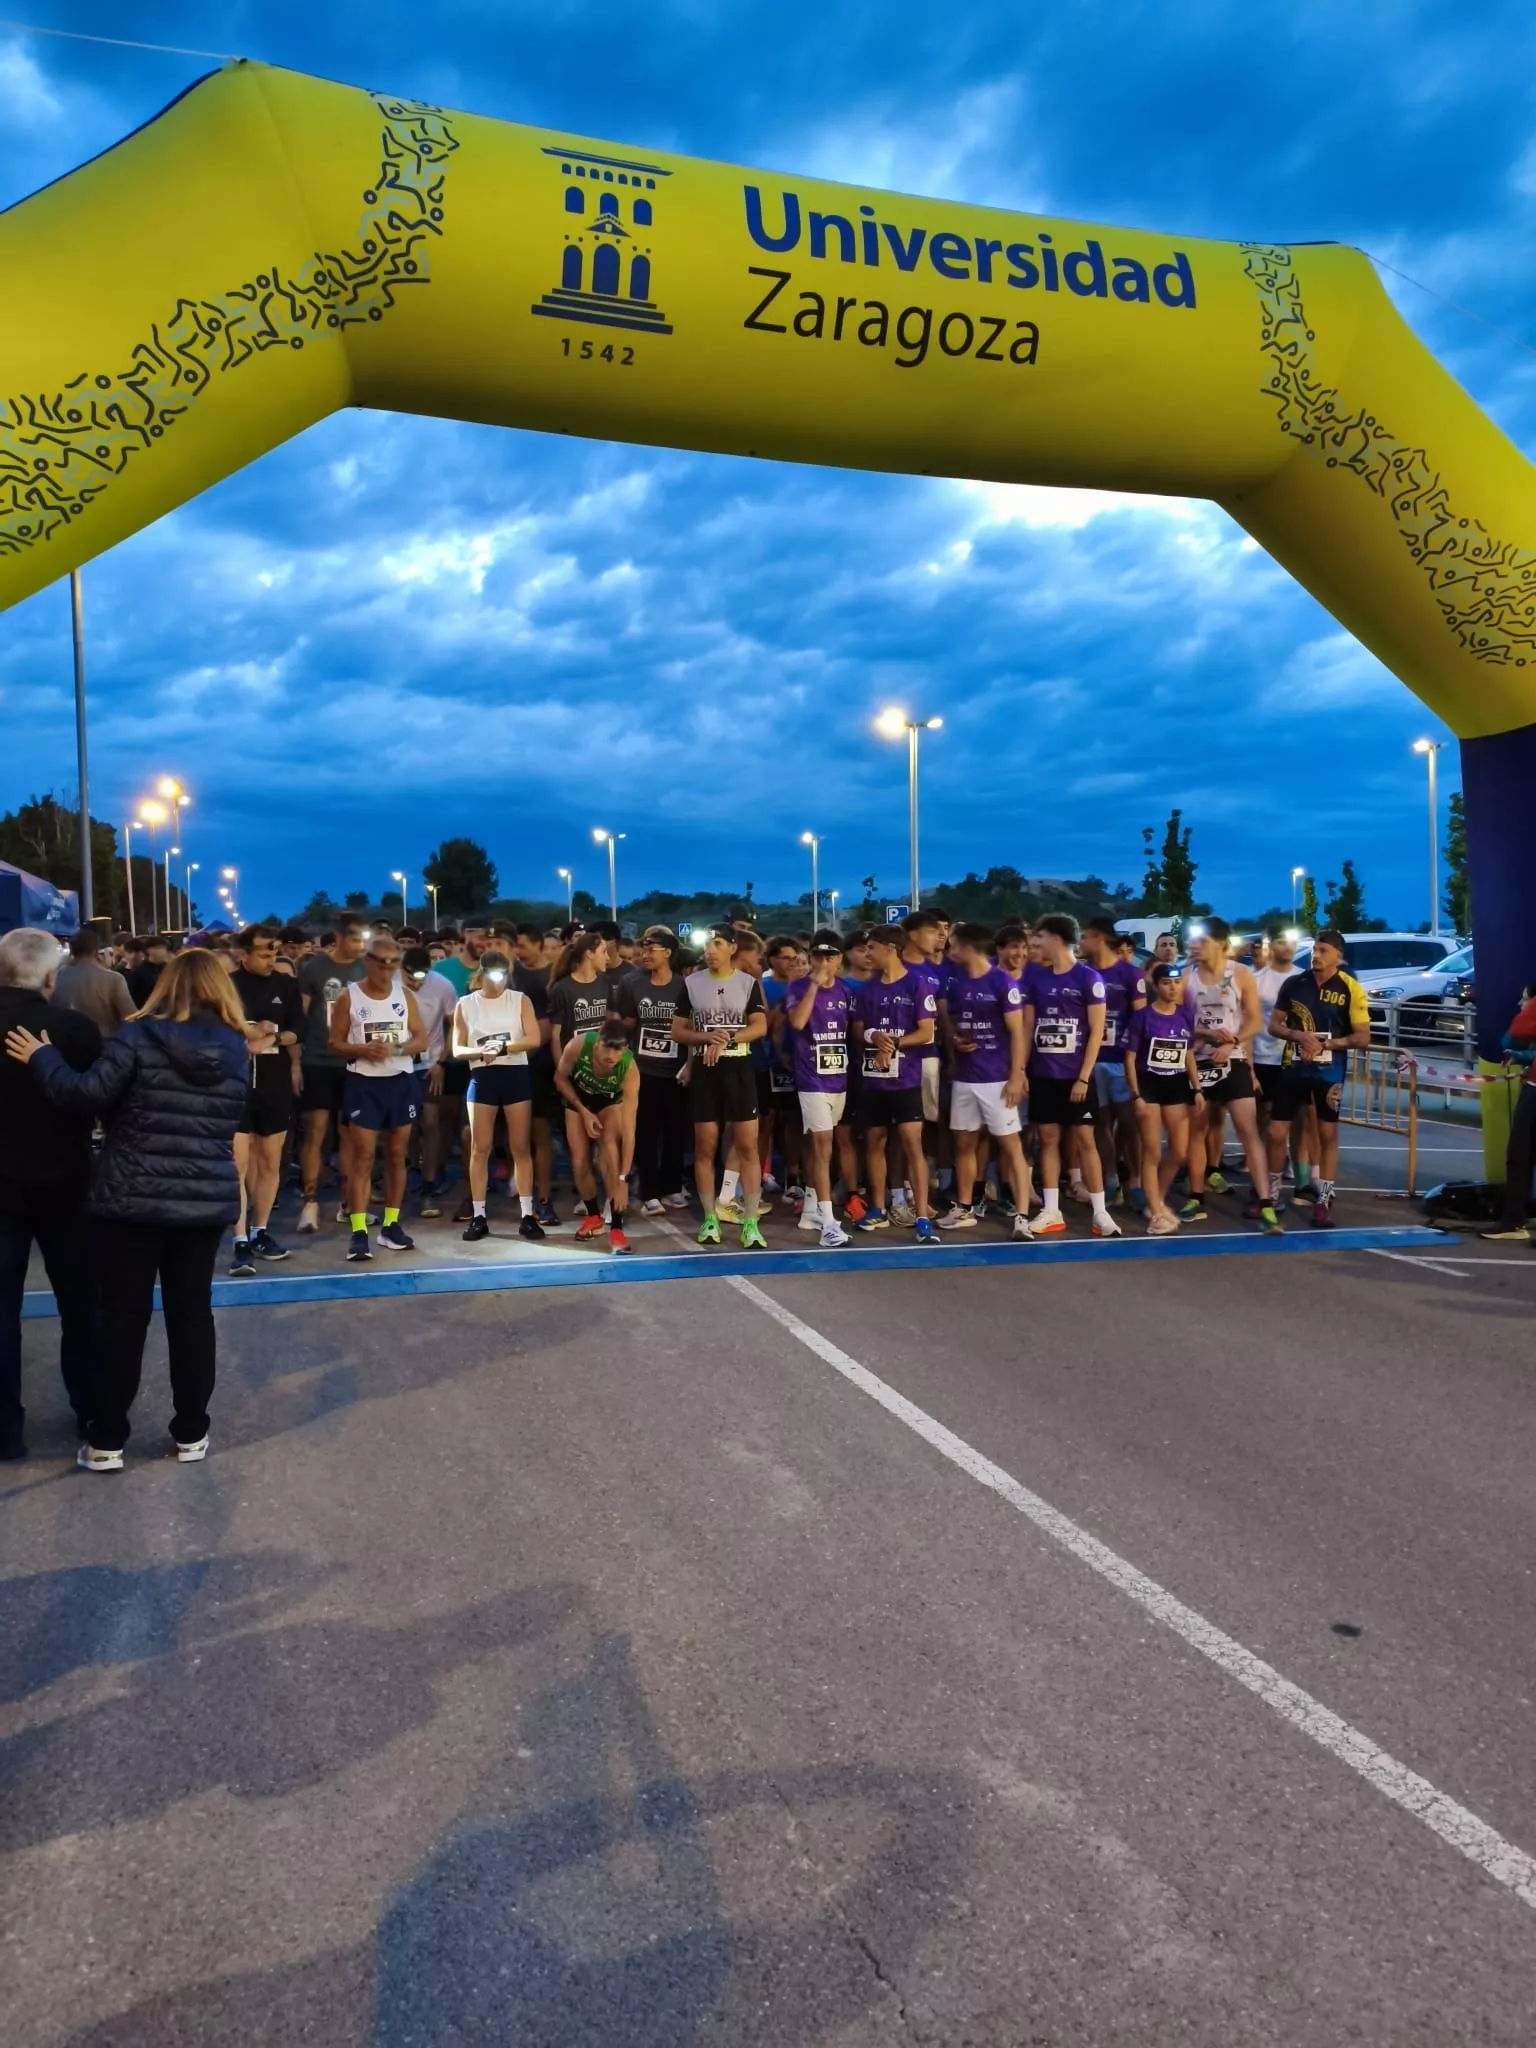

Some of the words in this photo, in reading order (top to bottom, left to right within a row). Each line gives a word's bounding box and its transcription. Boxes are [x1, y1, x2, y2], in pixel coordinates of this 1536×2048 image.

[744, 185, 1197, 309] Universidad
[744, 266, 1040, 368] Zaragoza
[561, 338, 634, 366] 1542
[888, 908, 900, 921] P
[1320, 989, 1346, 1006] 1306
[645, 1040, 667, 1050] 547
[1156, 1050, 1178, 1060] 699
